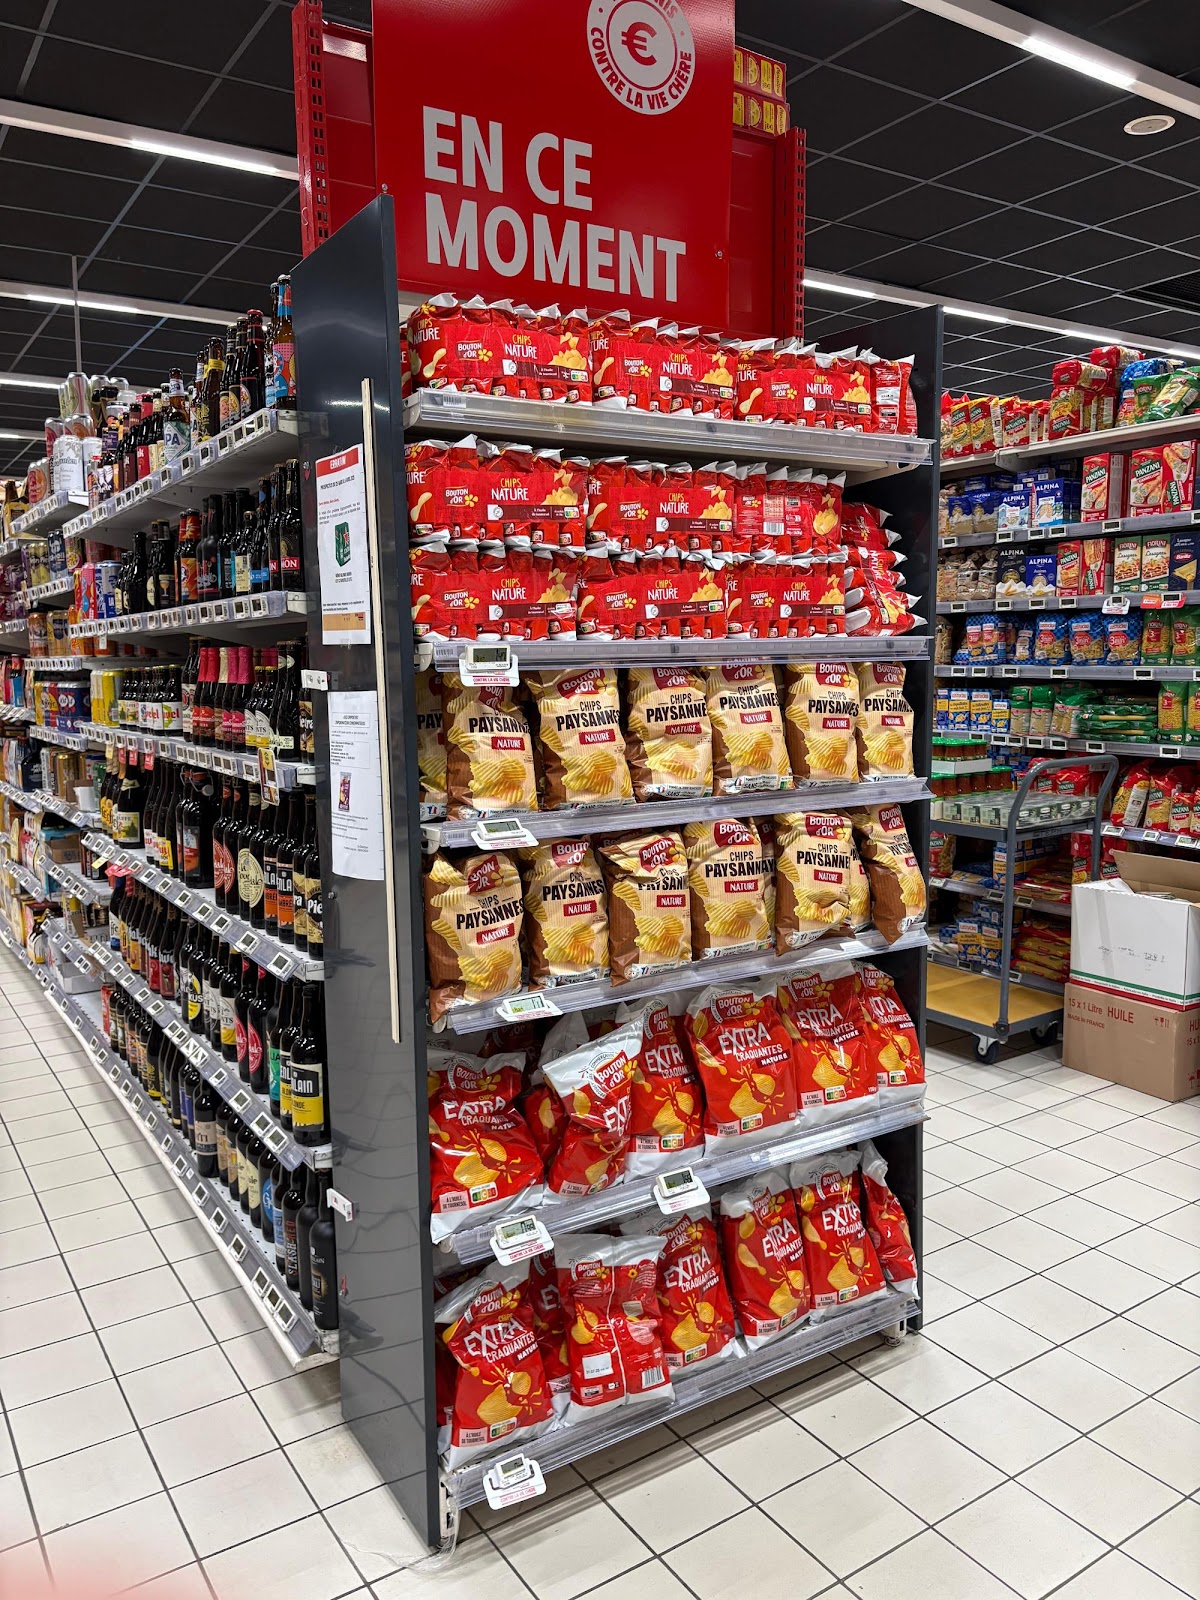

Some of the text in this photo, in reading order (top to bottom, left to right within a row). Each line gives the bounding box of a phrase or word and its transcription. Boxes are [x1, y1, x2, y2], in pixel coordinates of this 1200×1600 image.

[591, 27, 692, 110] CONTRE LA VIE CHÈRE
[423, 105, 592, 211] EN CE
[425, 192, 686, 302] MOMENT
[512, 334, 531, 345] CHIPS
[457, 343, 482, 351] BOUTON
[505, 344, 537, 360] NATURE
[624, 359, 644, 367] BOUTON
[670, 354, 688, 363] CHIPS
[662, 363, 693, 377] NATURE
[814, 375, 828, 384] CHIPS
[771, 383, 790, 391] BOUTON
[806, 383, 833, 395] NATURE
[1085, 468, 1106, 483] PANZANI
[1135, 462, 1160, 478] PANZANI
[500, 478, 522, 488] CHIPS
[1036, 483, 1059, 491] ALPINA
[446, 488, 469, 497] BOUTON
[491, 487, 529, 501] NATURE
[668, 493, 684, 502] CHIPS
[1170, 481, 1180, 506] PANZANI
[620, 503, 642, 511] BOUTON
[659, 501, 689, 514] NATURE
[1120, 542, 1137, 550] FIORINI
[1147, 540, 1167, 548] FIORINI
[1060, 553, 1077, 564] PANZANI
[869, 550, 883, 580] NATURE
[501, 578, 521, 588] CHIPS
[655, 579, 672, 588] CHIPS
[791, 582, 806, 590] CHIPS
[444, 591, 468, 601] BOUTON
[492, 587, 527, 600] NATURE
[606, 593, 628, 602] BOUTON
[648, 587, 679, 600] NATURE
[783, 590, 811, 601] NATURE
[657, 666, 690, 678] BOUTON
[819, 663, 846, 674] BOUTON
[876, 664, 900, 673] BOUTON
[562, 671, 601, 691] BOUTON
[738, 685, 760, 694] CHIPS
[828, 691, 846, 699] CHIPS
[670, 693, 692, 704] CHIPS
[580, 700, 602, 711] CHIPS
[556, 709, 620, 731] PAYSANNES
[743, 713, 769, 722] NATURE
[826, 719, 848, 728] NATURE
[670, 724, 697, 734] NATURE
[585, 732, 610, 742] NATURE
[497, 739, 522, 748] NATURE
[810, 816, 841, 827] BOUTON
[642, 838, 674, 862] BOUTON
[818, 843, 838, 853] CHIPS
[729, 851, 754, 862] CHIPS
[817, 872, 838, 882] NATURE
[542, 879, 605, 902] PAYSANNES
[730, 881, 756, 891] NATURE
[480, 894, 498, 909] CHIPS
[660, 897, 682, 906] NATURE
[456, 898, 524, 930] PAYSANNES
[568, 903, 592, 914] NATURE
[481, 927, 511, 942] NATURE
[793, 977, 819, 990] BOUTON
[718, 996, 750, 1008] BOUTON
[1068, 997, 1076, 1007] 15
[1083, 1002, 1086, 1010] 1
[1088, 1003, 1102, 1014] Litre
[1107, 1006, 1134, 1024] HUILE
[797, 1004, 843, 1030] EXTRA
[1067, 1013, 1080, 1021] MADE
[1087, 1018, 1105, 1029] FRANCE
[718, 1022, 771, 1055] EXTRA
[834, 1030, 859, 1043] NATURE
[736, 1045, 783, 1062] CRAQUANTES
[761, 1053, 788, 1065] NATURE
[456, 1067, 483, 1079] BOUTON
[598, 1056, 627, 1082] BOUTON
[442, 1096, 506, 1119] EXTRA
[822, 1201, 861, 1230] EXTRA
[663, 1219, 690, 1239] BOUTON
[578, 1262, 600, 1271] BOUTON
[664, 1246, 711, 1288] EXTRA
[681, 1267, 715, 1292] CRAQUANTES
[475, 1289, 504, 1307] BOUTON
[464, 1317, 524, 1356] EXTRA
[485, 1332, 535, 1363] CRAQUANTES
[517, 1344, 539, 1361] NATURE
